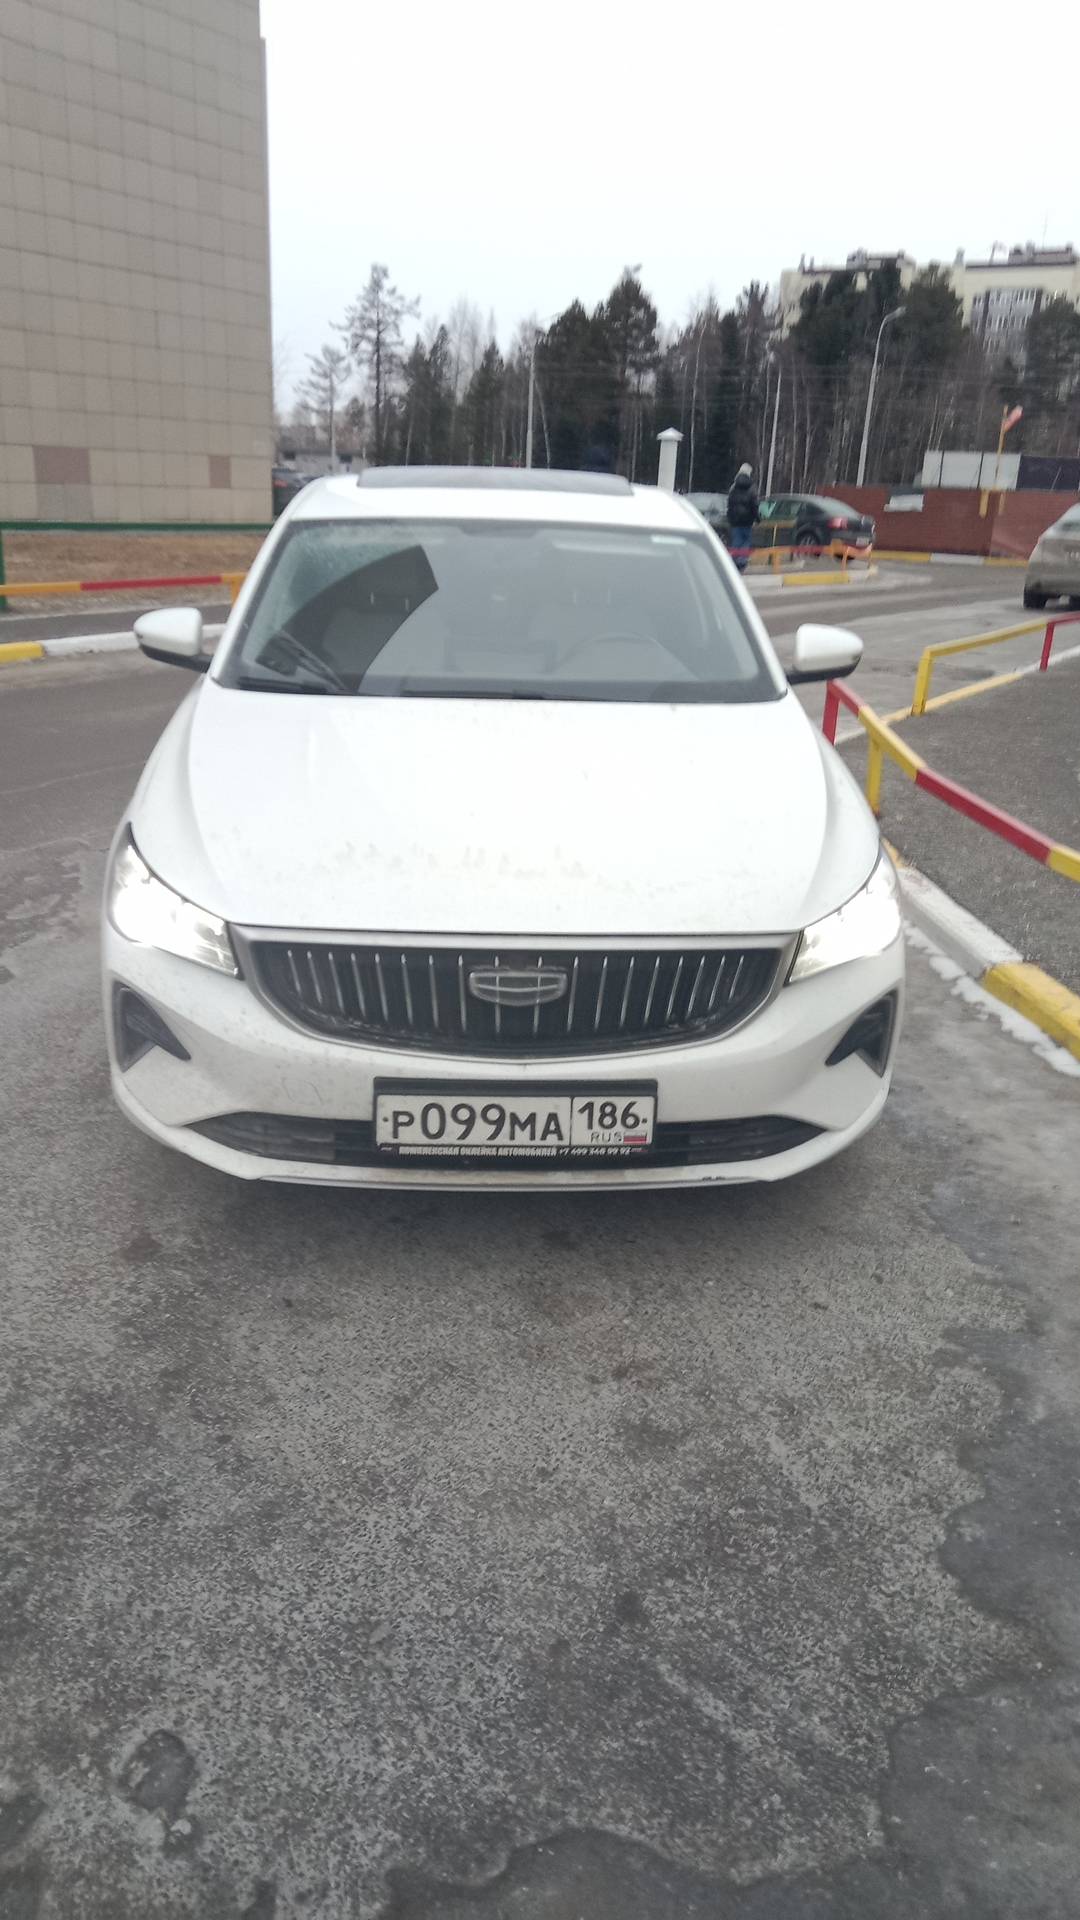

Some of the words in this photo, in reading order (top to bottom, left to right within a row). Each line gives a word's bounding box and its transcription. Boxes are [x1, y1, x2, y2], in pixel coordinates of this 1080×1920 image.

[392, 1102, 564, 1141] Р099МА
[578, 1101, 640, 1130] 186
[590, 1132, 623, 1143] RUS
